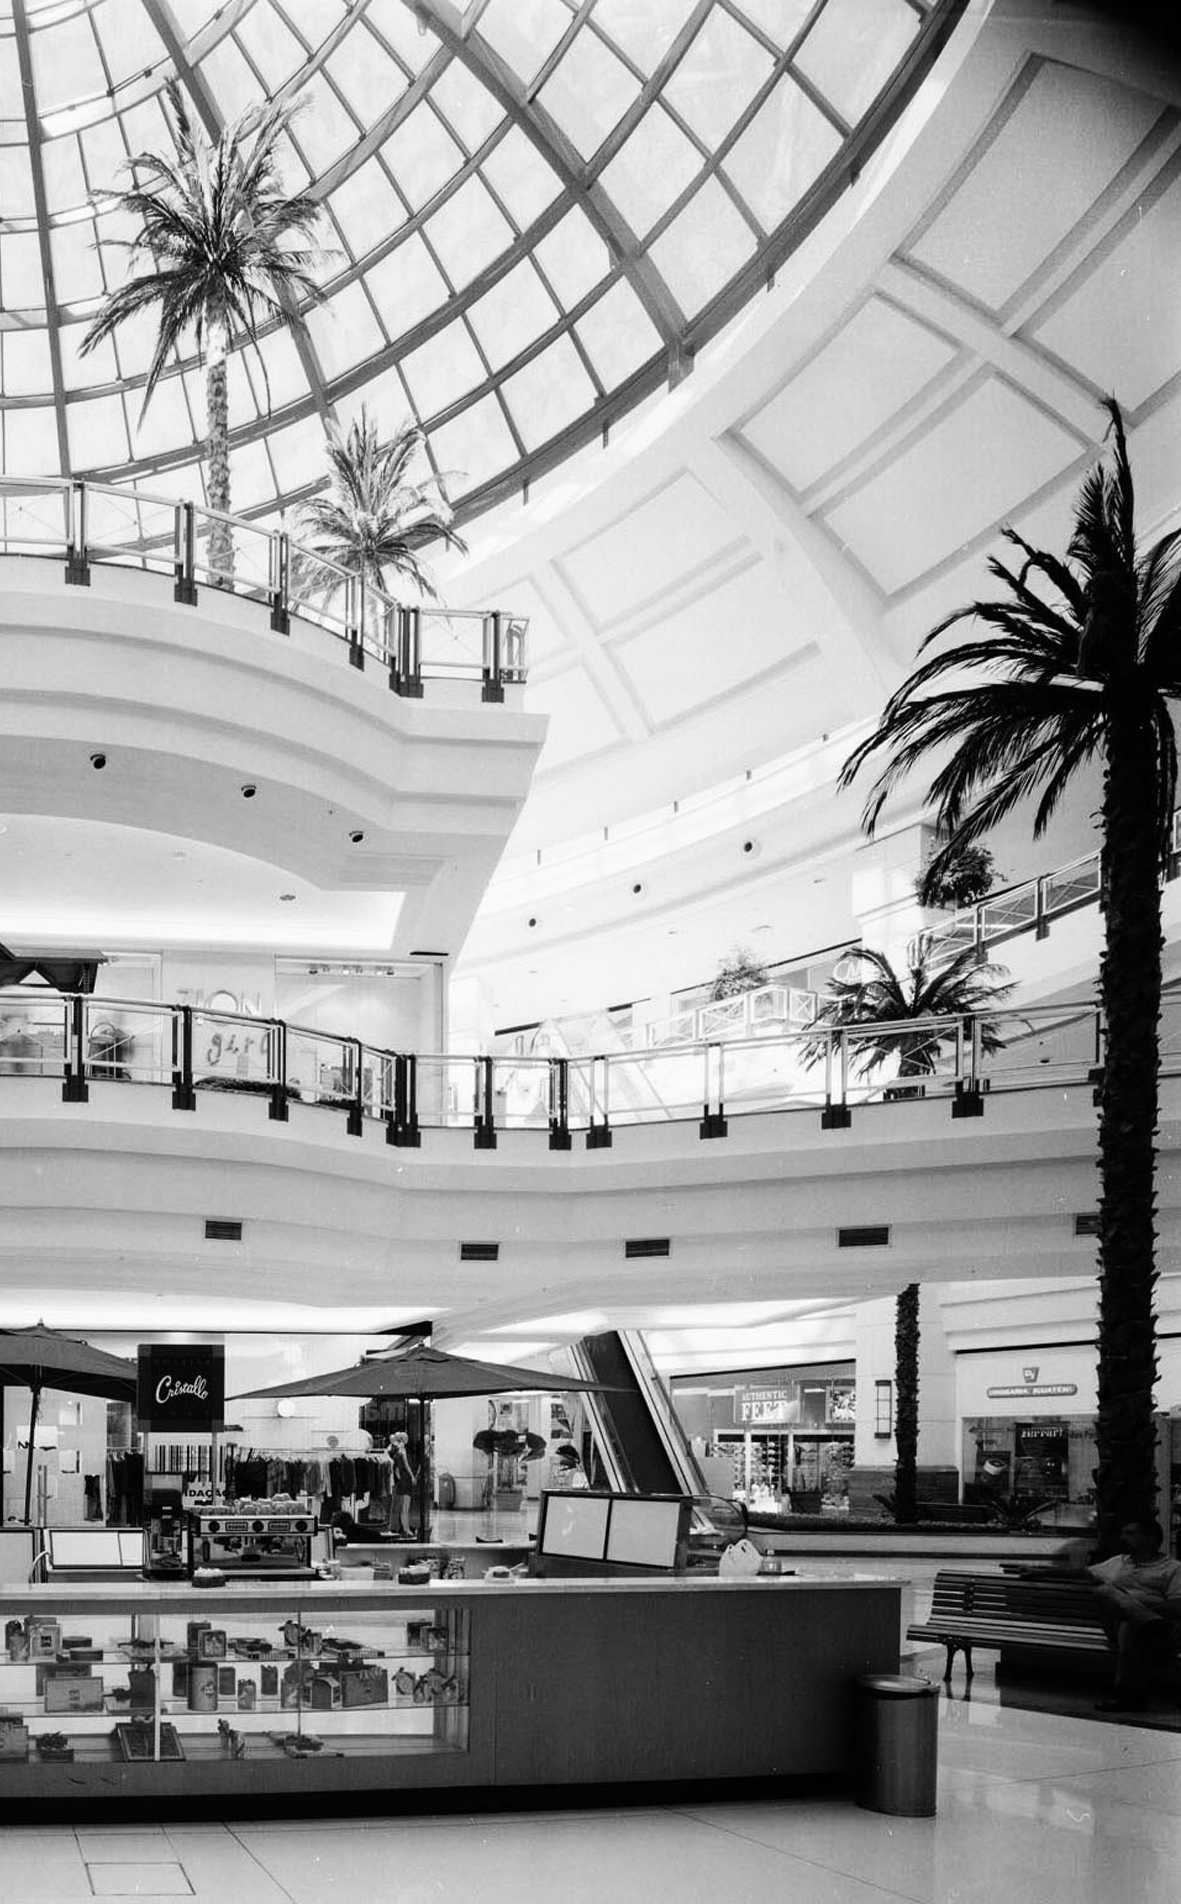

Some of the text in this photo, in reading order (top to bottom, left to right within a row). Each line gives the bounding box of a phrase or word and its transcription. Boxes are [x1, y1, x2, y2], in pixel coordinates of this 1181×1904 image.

[155, 1374, 209, 1404] Cristallo
[741, 1390, 788, 1401] AUTHENTIC
[740, 1400, 789, 1421] FEET
